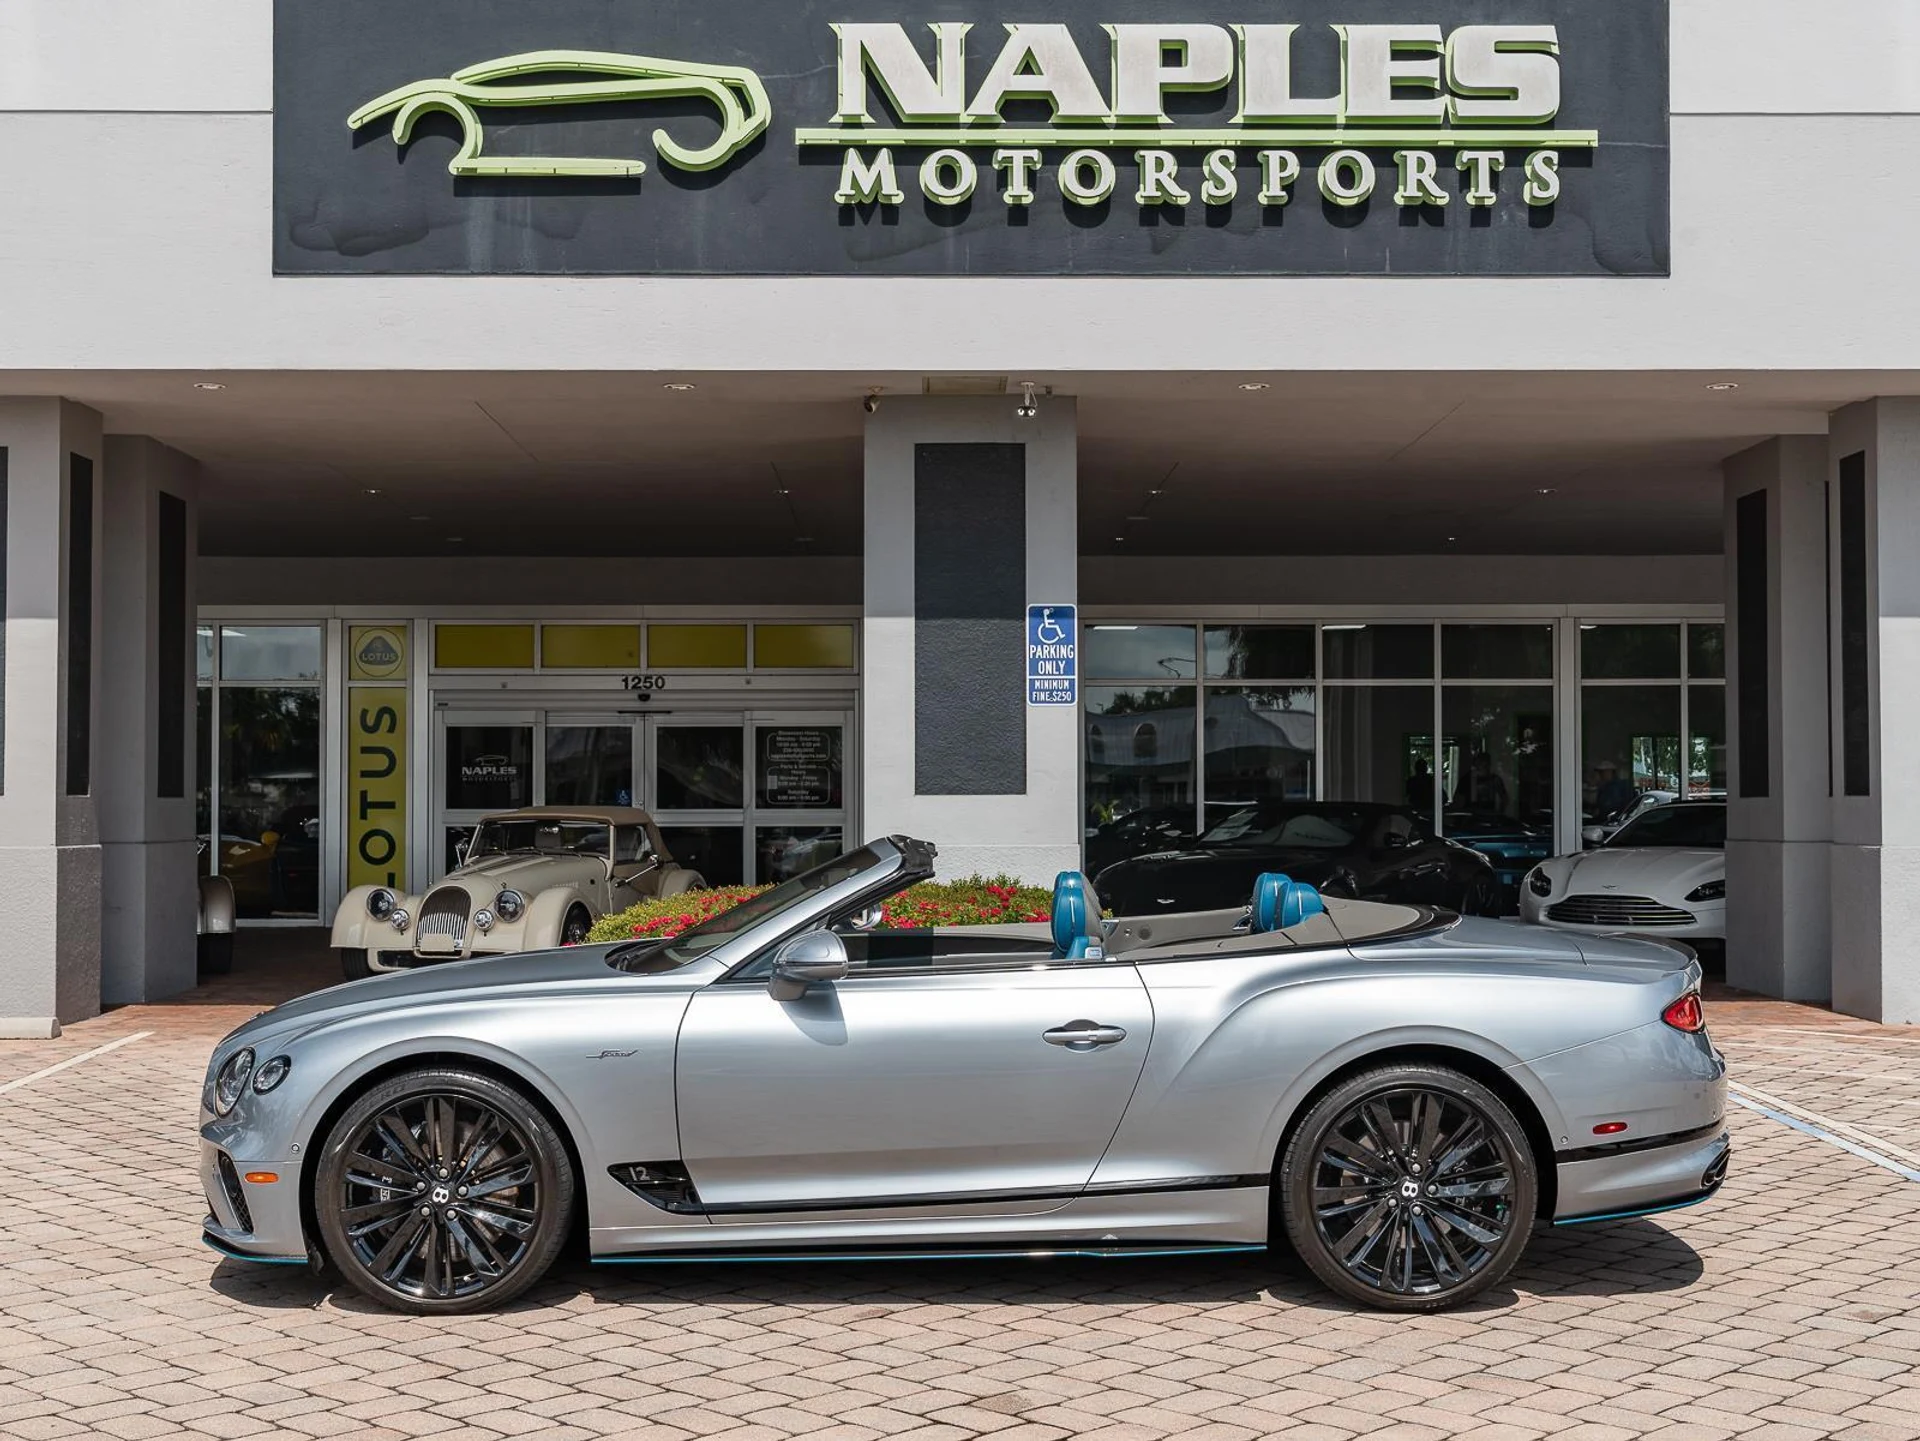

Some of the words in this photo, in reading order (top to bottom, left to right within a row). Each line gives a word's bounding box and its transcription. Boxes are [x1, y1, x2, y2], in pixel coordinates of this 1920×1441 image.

[828, 22, 1563, 125] NAPLES
[835, 147, 1562, 207] MOTORSPORTS
[362, 652, 397, 661] LOTUS
[1029, 644, 1074, 659] PARKING
[1038, 660, 1066, 675] ONLY
[621, 675, 665, 689] 1250
[1034, 679, 1070, 690] MINIMUM
[1032, 691, 1050, 702] FINE
[1052, 691, 1072, 702] $250
[461, 766, 518, 775] NAPLES
[629, 1166, 650, 1181] 12
